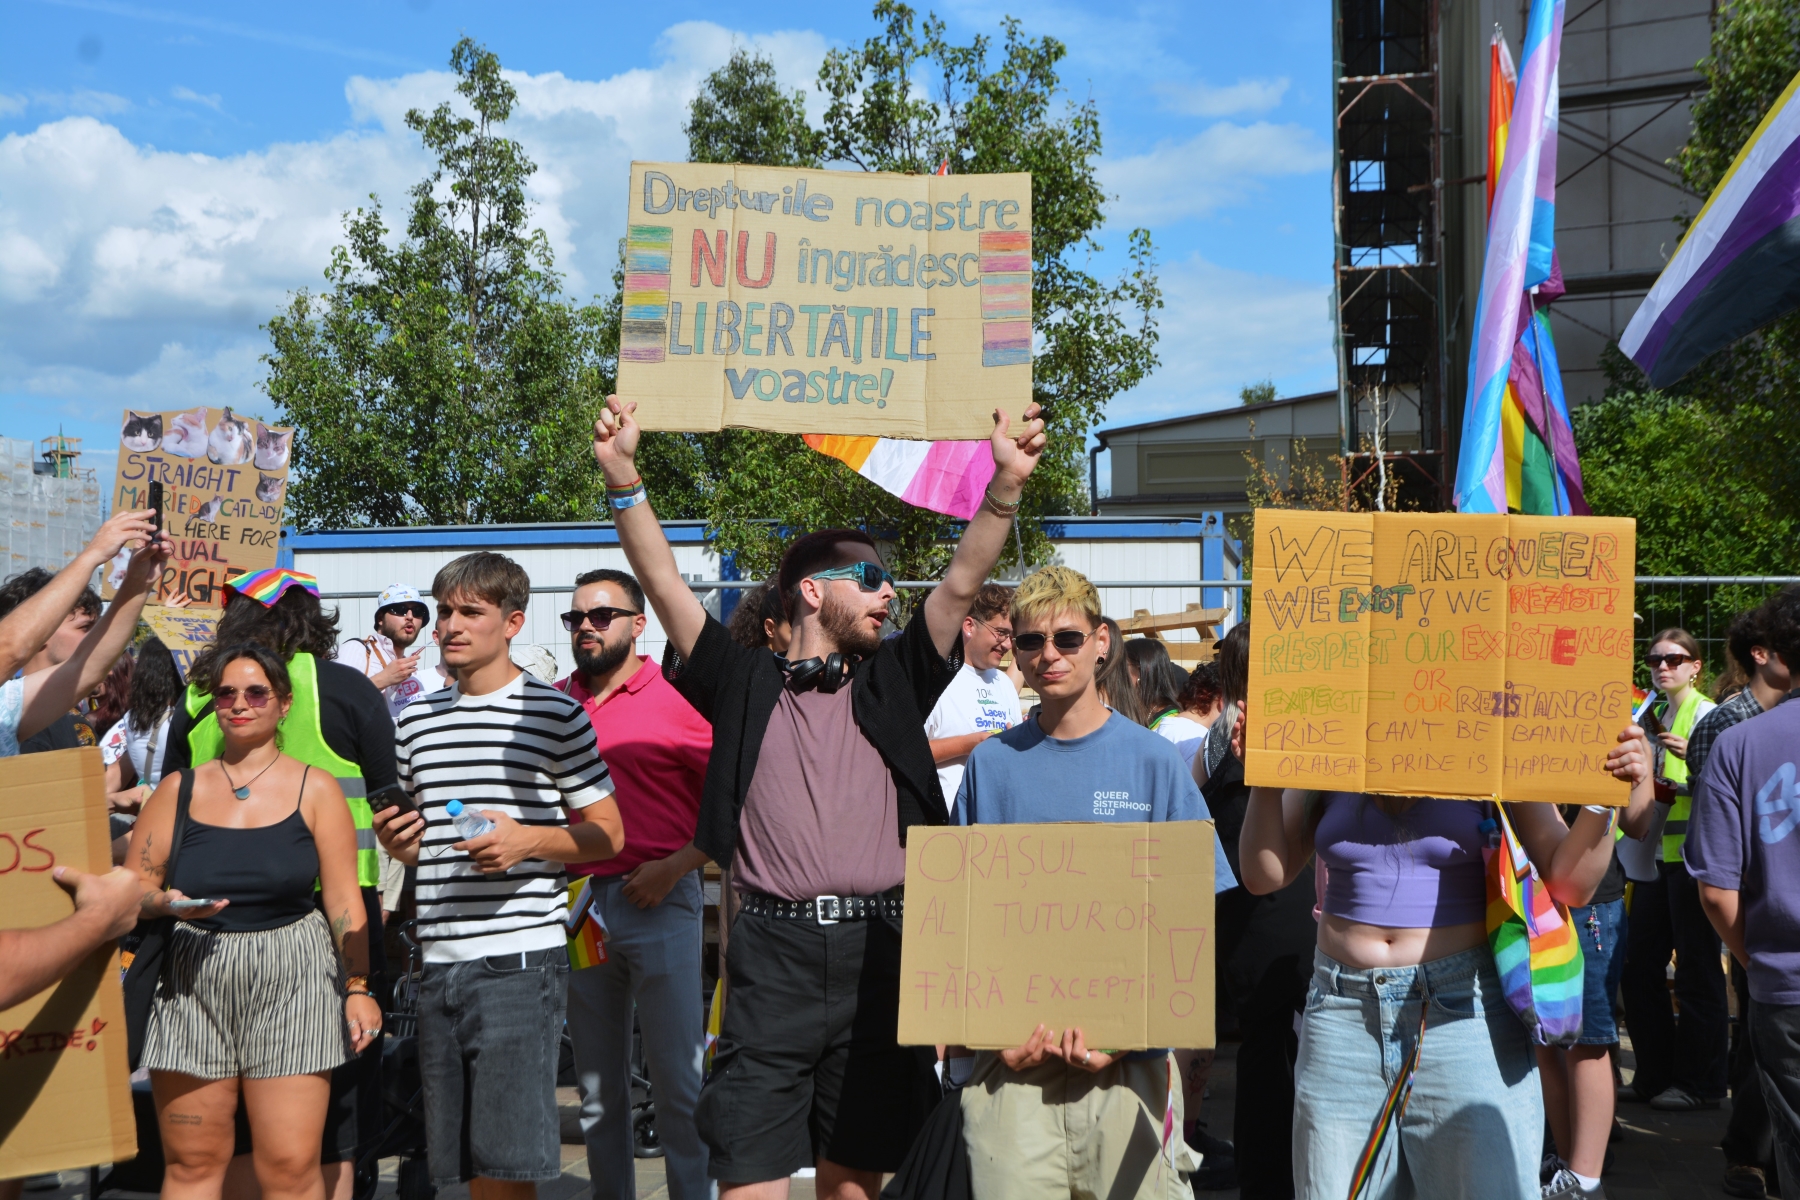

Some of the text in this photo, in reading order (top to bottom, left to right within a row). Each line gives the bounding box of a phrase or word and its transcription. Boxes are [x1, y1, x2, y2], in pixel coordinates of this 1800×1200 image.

[643, 171, 1019, 230] Drepturile noastre
[690, 229, 980, 291] NU îngrădesc
[669, 301, 936, 363] LIBERTĂȚILE
[725, 367, 894, 408] voastre!
[170, 540, 228, 563] QUAL
[185, 523, 231, 540] HERE
[240, 528, 277, 548] FOR
[1269, 525, 1619, 587] WE ARE QUEER
[1264, 585, 1331, 631] WE
[1446, 589, 1493, 615] WE
[1263, 629, 1397, 676] RESPECT
[1405, 629, 1459, 663] OUR
[1263, 684, 1396, 717] EXPECT
[1404, 691, 1455, 714] OUR
[1413, 668, 1453, 693] OR
[1365, 718, 1445, 743] CAN'T
[1456, 719, 1492, 742] BE
[1511, 722, 1608, 746] BANNED
[1093, 791, 1130, 801] QUEER
[1093, 800, 1152, 812] SISTERHOOD
[1093, 808, 1116, 816] CLUJ
[918, 832, 1162, 888] ORAȘUL E
[919, 896, 1162, 937] AL TUTUROR
